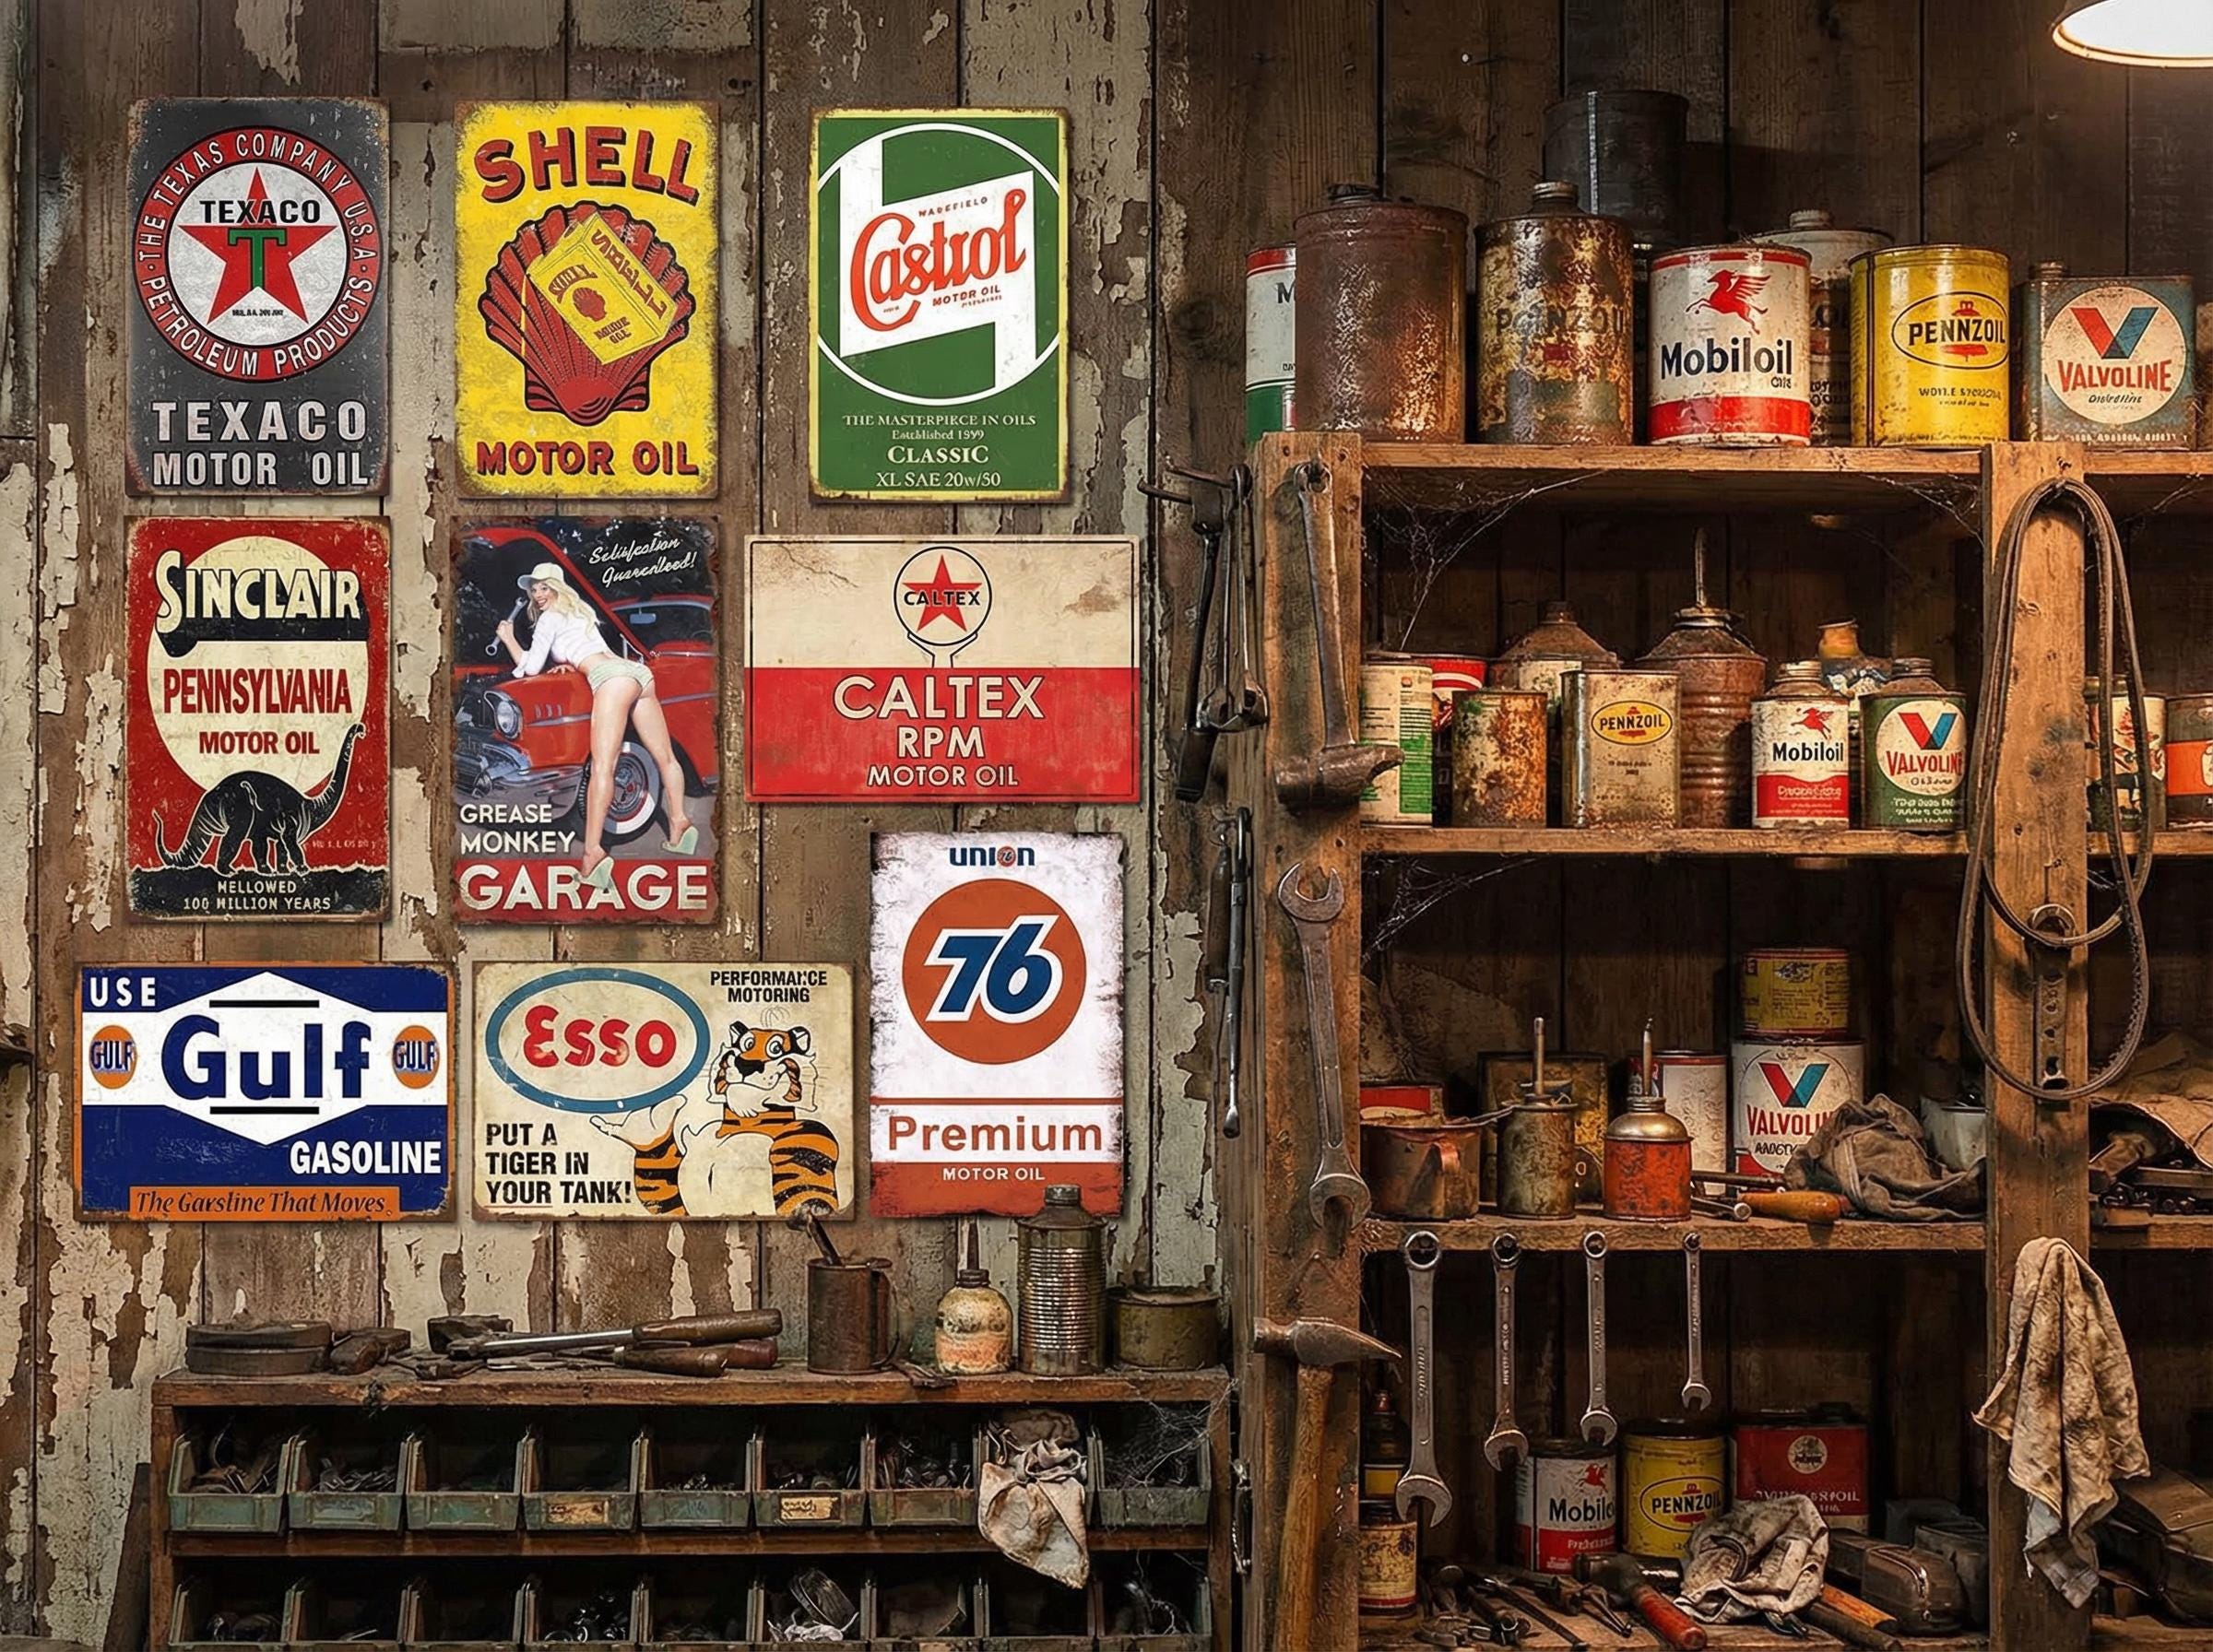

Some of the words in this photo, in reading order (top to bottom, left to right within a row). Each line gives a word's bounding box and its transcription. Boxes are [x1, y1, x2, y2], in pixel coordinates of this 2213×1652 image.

[474, 126, 700, 206] SHELL
[137, 214, 167, 262] THE
[154, 140, 224, 207] TEXAS
[236, 133, 351, 195] COMPANY
[199, 200, 321, 224] TEXACO
[851, 188, 1026, 332] Castrol
[981, 285, 1000, 295] OIL
[141, 276, 258, 376] PETROLEUM
[274, 276, 373, 375] PRODUCTS
[1908, 318, 2006, 346] PENNZOIL
[1661, 336, 1793, 380] Mobiloil
[2057, 359, 2172, 393] VALVOLINE
[151, 400, 367, 442] TEXACO
[843, 415, 874, 425] THE
[982, 415, 999, 425] IN
[1003, 415, 1035, 425] OILS
[152, 452, 277, 487] MOTOR
[311, 452, 368, 487] OIL
[477, 441, 614, 477] MOTOR
[633, 441, 699, 477] OIL
[887, 445, 988, 464] CLASSIC
[876, 472, 902, 487] XL
[905, 472, 941, 487] SAE
[155, 549, 360, 633] SINCLAIR
[904, 591, 980, 606] CALTEX
[163, 668, 352, 714] PENNSYLVANIA
[834, 675, 1044, 719] CALTEX
[1600, 714, 1664, 731] PENNZOIL
[199, 731, 277, 755] MOTOR
[284, 731, 320, 755] OIL
[898, 726, 985, 758] RPM
[1772, 742, 1844, 761] Mobiloil
[868, 765, 965, 786] MOTOR
[976, 765, 1018, 786] OIL
[460, 804, 552, 823] GREASE
[460, 831, 576, 855] MONKEY
[184, 898, 209, 910] 100
[285, 897, 331, 910] YEARS
[460, 865, 708, 911] GARAGE
[931, 919, 1056, 1019] 76
[89, 976, 156, 1007] USE
[728, 987, 810, 1002] MOTORING
[91, 1040, 136, 1073] GULF
[161, 1014, 372, 1100] Gulf
[394, 1040, 438, 1073] GULF
[486, 1124, 532, 1146] PUT
[540, 1124, 557, 1146] A
[889, 1115, 1101, 1151] Premium
[1746, 1103, 1833, 1136] VALVOLI
[290, 1140, 442, 1174] GASOLINE
[486, 1152, 556, 1174] TIGER
[565, 1152, 588, 1174] IN
[943, 1168, 1008, 1181] MOTOR
[1015, 1168, 1045, 1181] OIL
[137, 1191, 172, 1213] The
[269, 1191, 316, 1212] That
[486, 1181, 551, 1204] YOUR
[561, 1181, 632, 1204] TANK!
[1652, 1489, 1722, 1514] PENNZOIL
